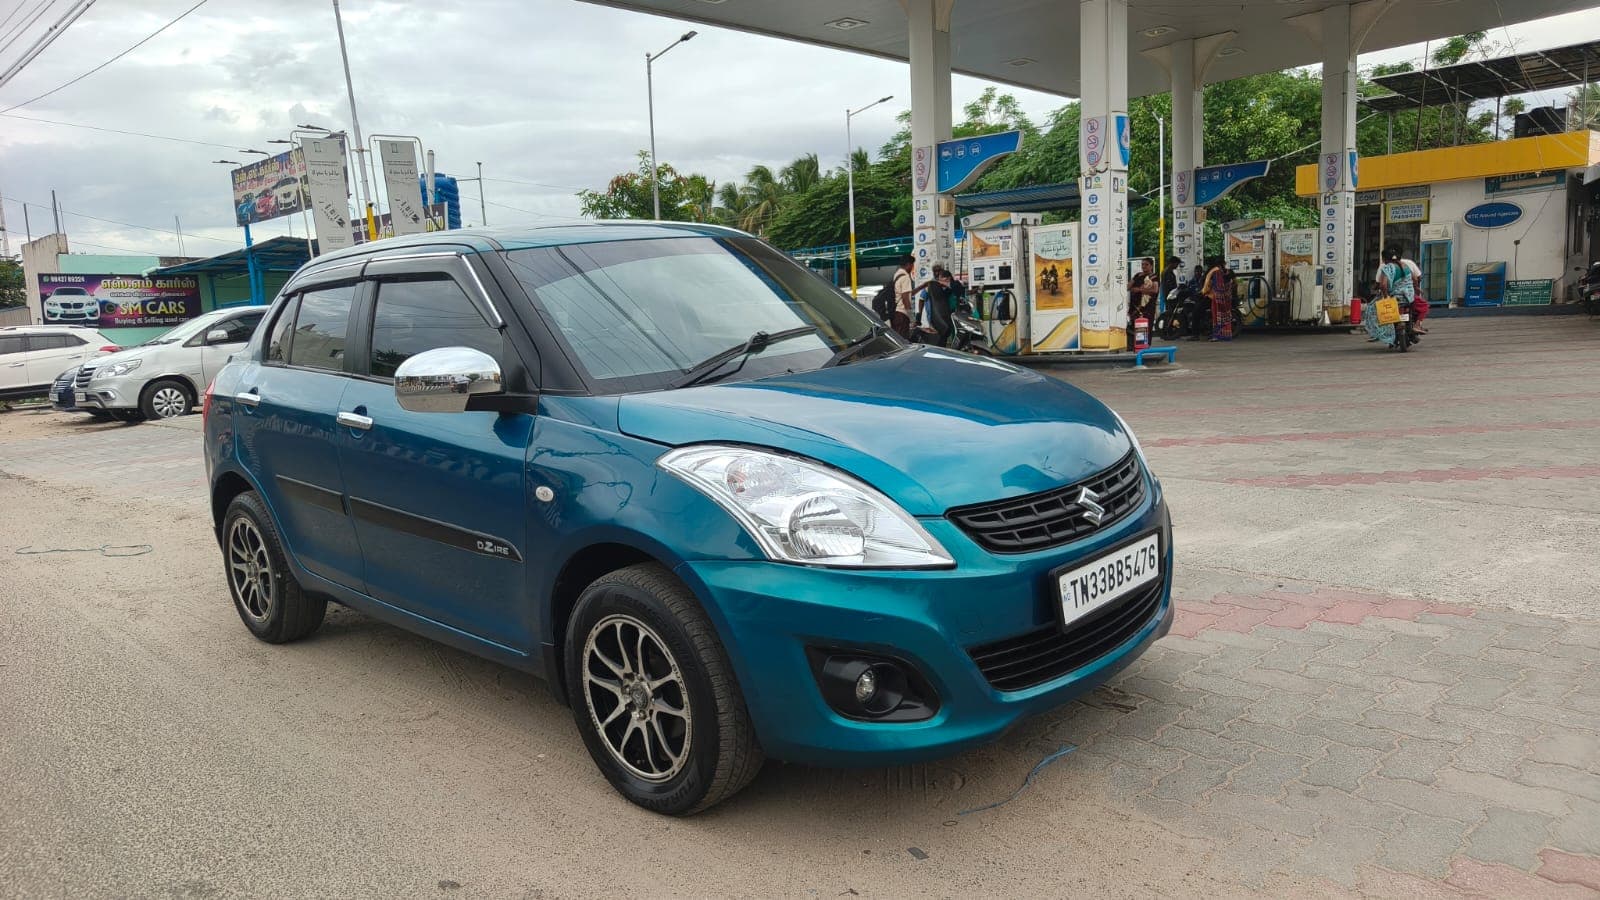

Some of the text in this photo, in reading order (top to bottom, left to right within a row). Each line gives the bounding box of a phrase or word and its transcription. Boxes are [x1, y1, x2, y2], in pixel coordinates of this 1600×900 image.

[155, 277, 196, 289] கார்ஸ்
[120, 301, 186, 315] SM CARS
[114, 317, 136, 325] Buying
[1070, 543, 1156, 609] TN33BB5476
